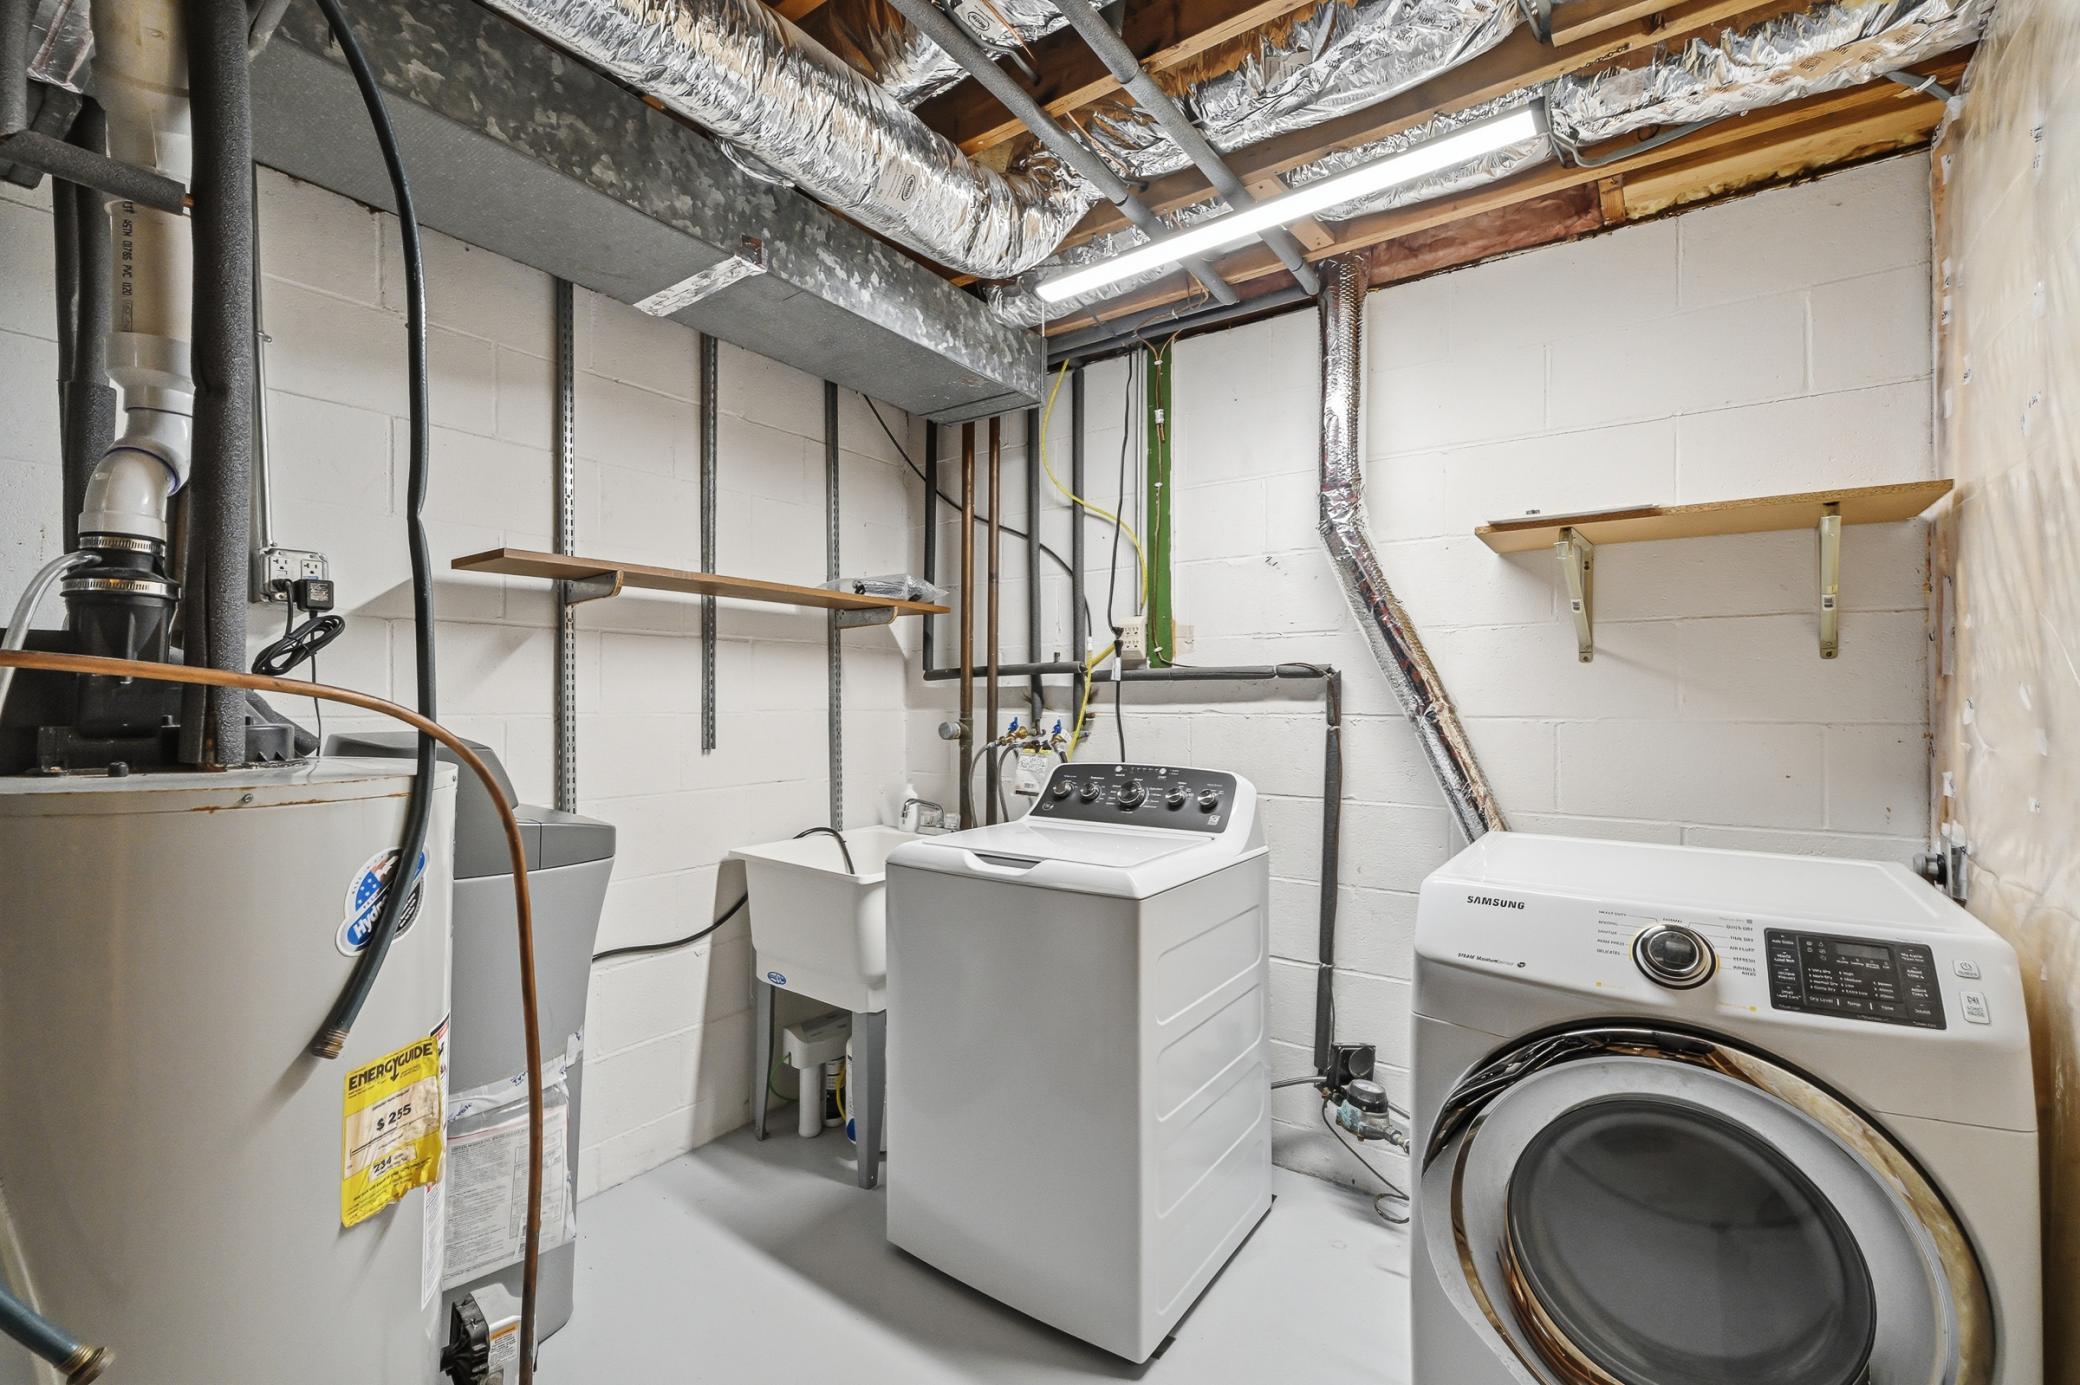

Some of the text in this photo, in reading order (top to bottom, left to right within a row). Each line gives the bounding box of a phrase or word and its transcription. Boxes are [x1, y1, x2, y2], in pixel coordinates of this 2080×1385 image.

[122, 264, 133, 278] PVC
[122, 281, 133, 296] 1120
[1466, 895, 1526, 910] SAMSUNG
[348, 1042, 433, 1091] ENERGYGUIDE
[376, 1103, 412, 1131] $ 255
